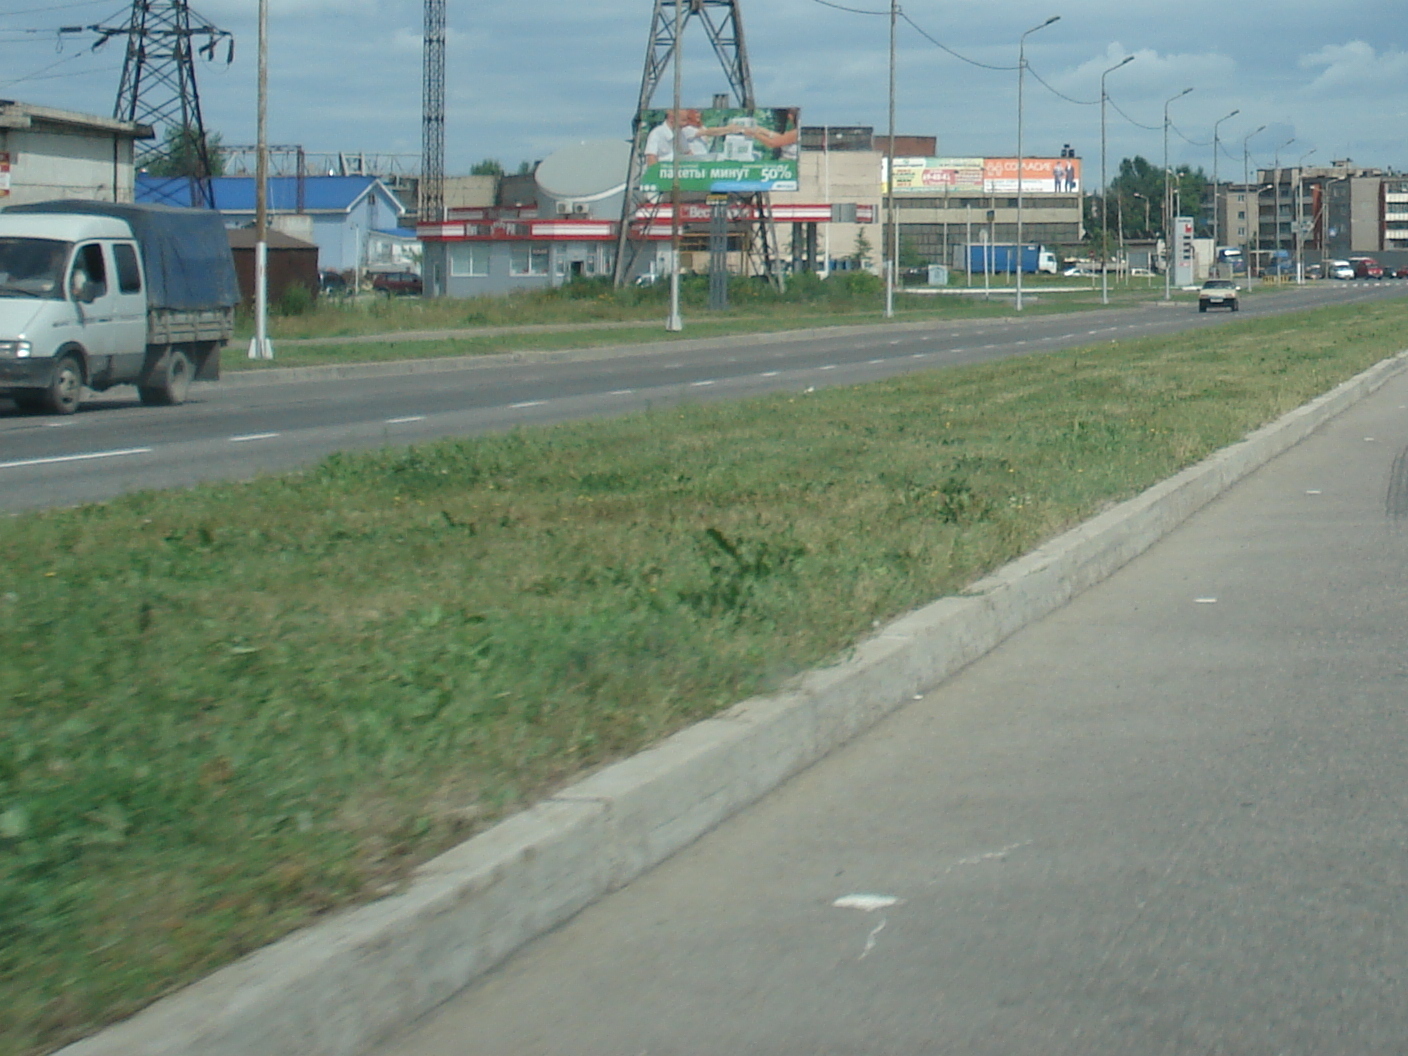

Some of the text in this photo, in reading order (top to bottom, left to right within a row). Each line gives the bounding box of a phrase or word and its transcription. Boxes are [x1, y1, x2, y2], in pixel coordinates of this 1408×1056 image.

[710, 168, 750, 181] минут
[761, 164, 792, 182] 50%
[1003, 161, 1051, 172] СОЛАСИЕ
